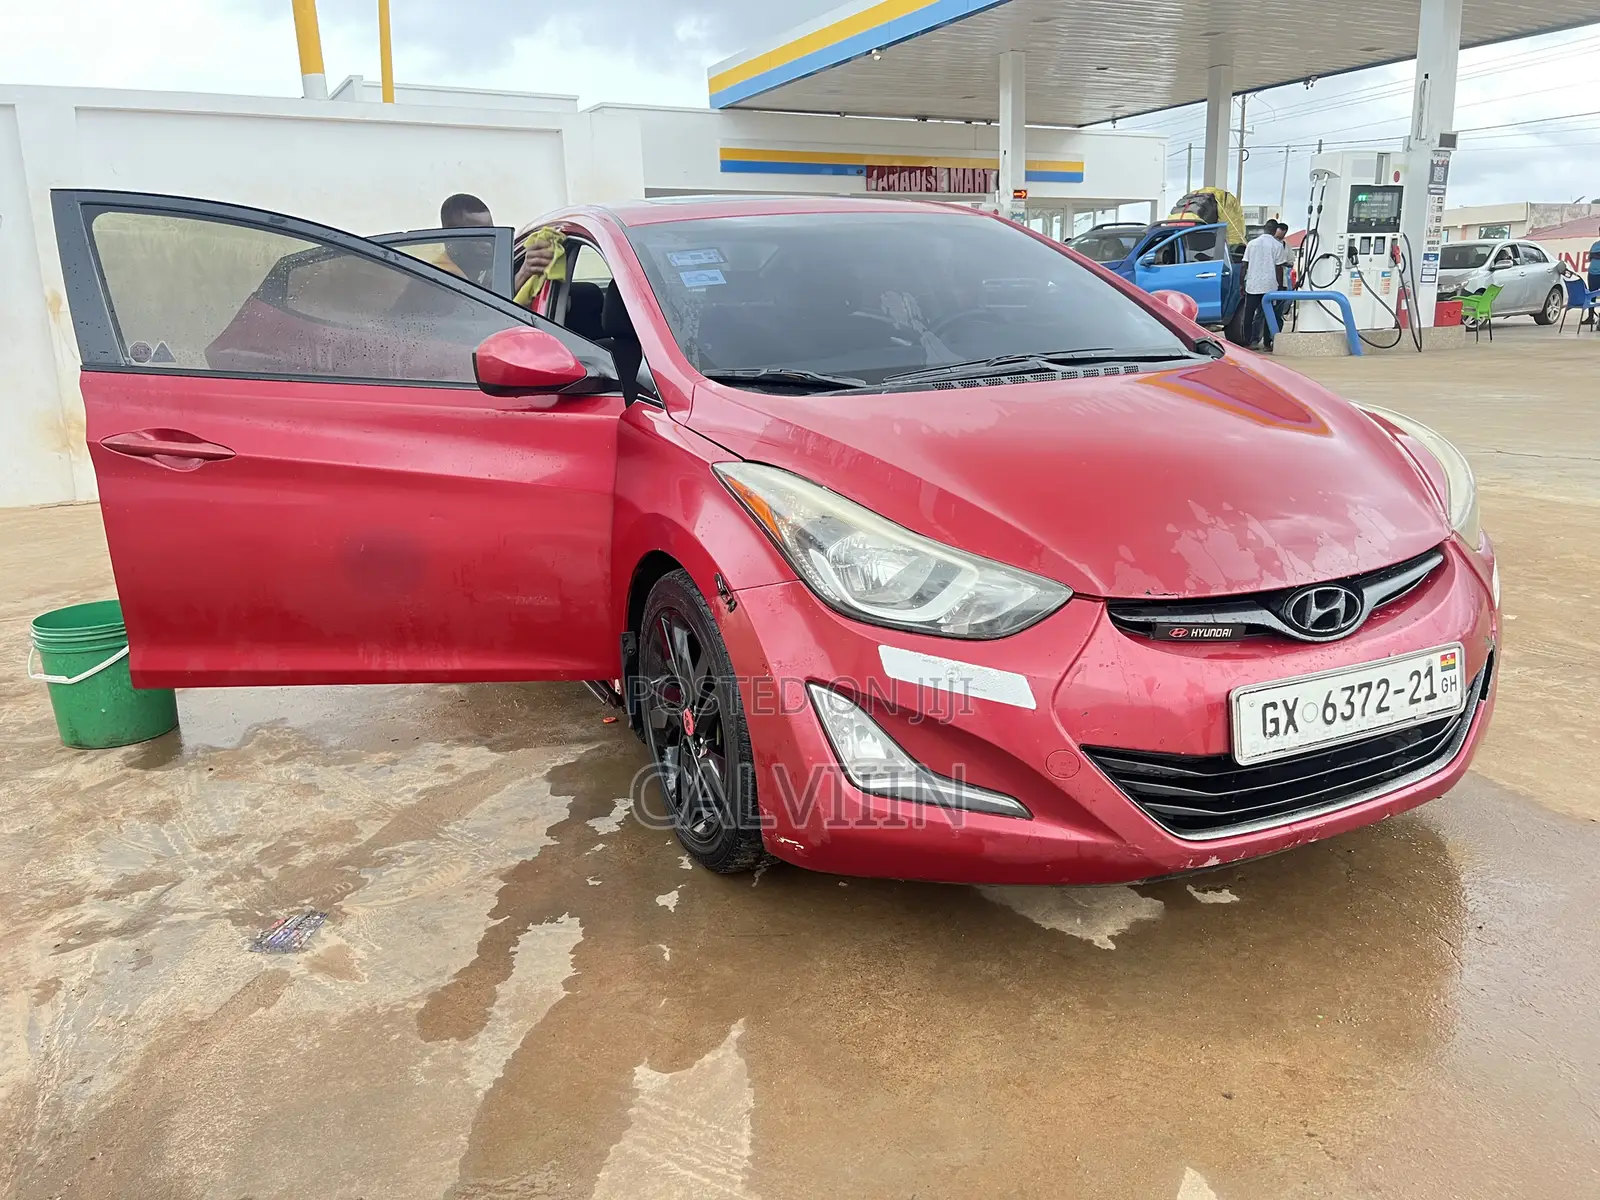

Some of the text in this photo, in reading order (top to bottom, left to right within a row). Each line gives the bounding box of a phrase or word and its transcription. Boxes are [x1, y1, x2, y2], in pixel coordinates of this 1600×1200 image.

[950, 168, 998, 193] MART
[1191, 628, 1232, 638] HYUNDAI
[1441, 674, 1458, 694] GH
[1261, 665, 1438, 740] GX 6372-21
